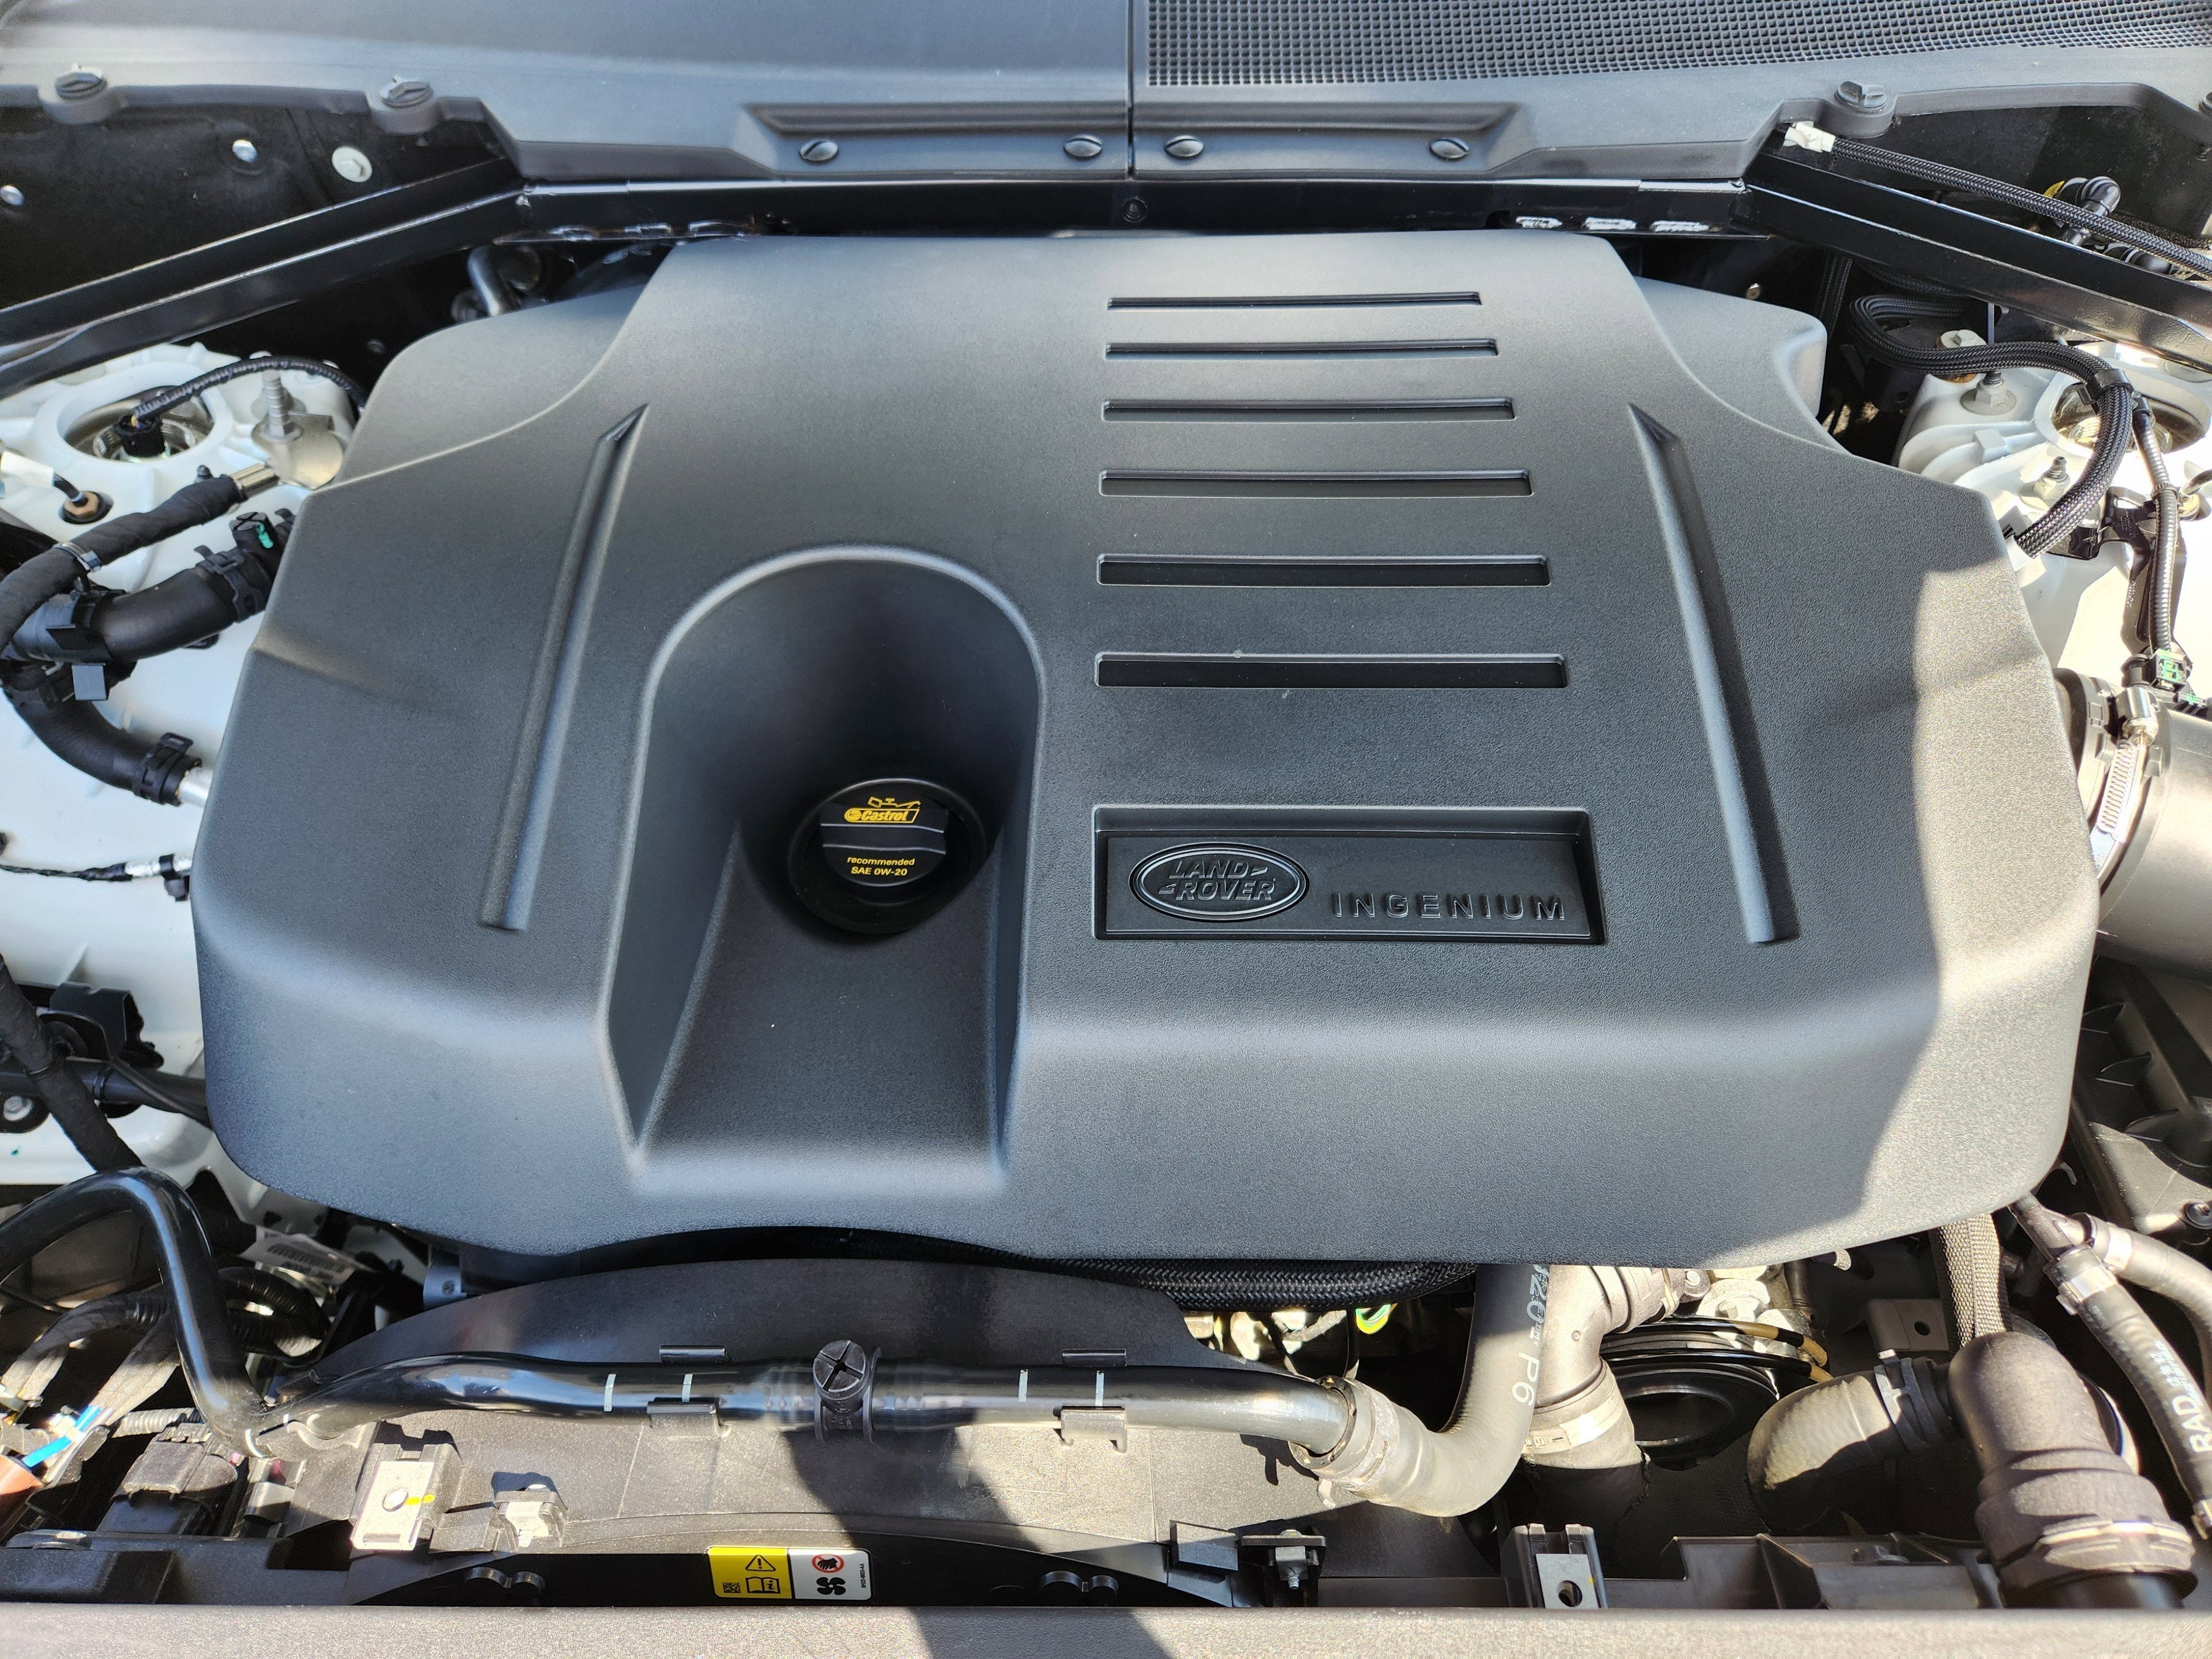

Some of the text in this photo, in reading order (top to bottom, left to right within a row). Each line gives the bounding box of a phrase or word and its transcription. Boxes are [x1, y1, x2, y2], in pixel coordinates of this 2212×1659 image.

[861, 810, 909, 821] Castrol
[847, 857, 915, 866] recommended
[851, 866, 908, 876] SAE 0W-20
[1168, 860, 1249, 879] LAND
[1175, 880, 1275, 901] ROVER
[1332, 892, 1565, 920] INGENIUM
